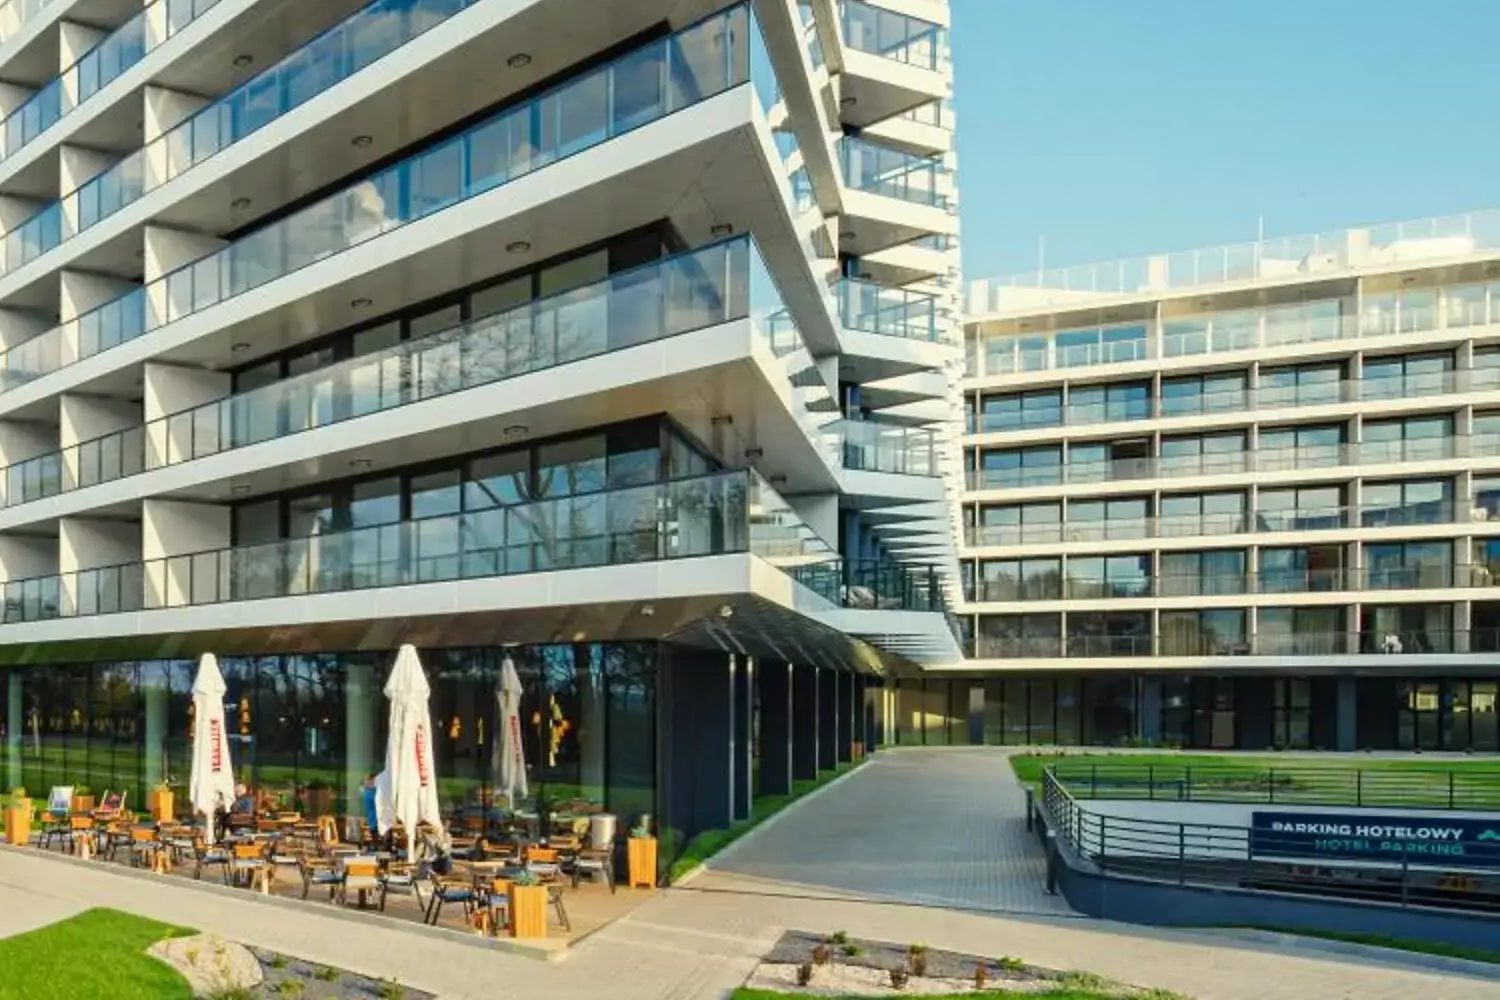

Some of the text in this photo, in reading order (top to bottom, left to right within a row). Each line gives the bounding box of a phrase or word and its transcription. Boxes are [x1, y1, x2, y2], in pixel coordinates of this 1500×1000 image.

[1271, 821, 1463, 840] PARKING HOTELOWY
[1315, 839, 1465, 855] HOTEL PARKING
